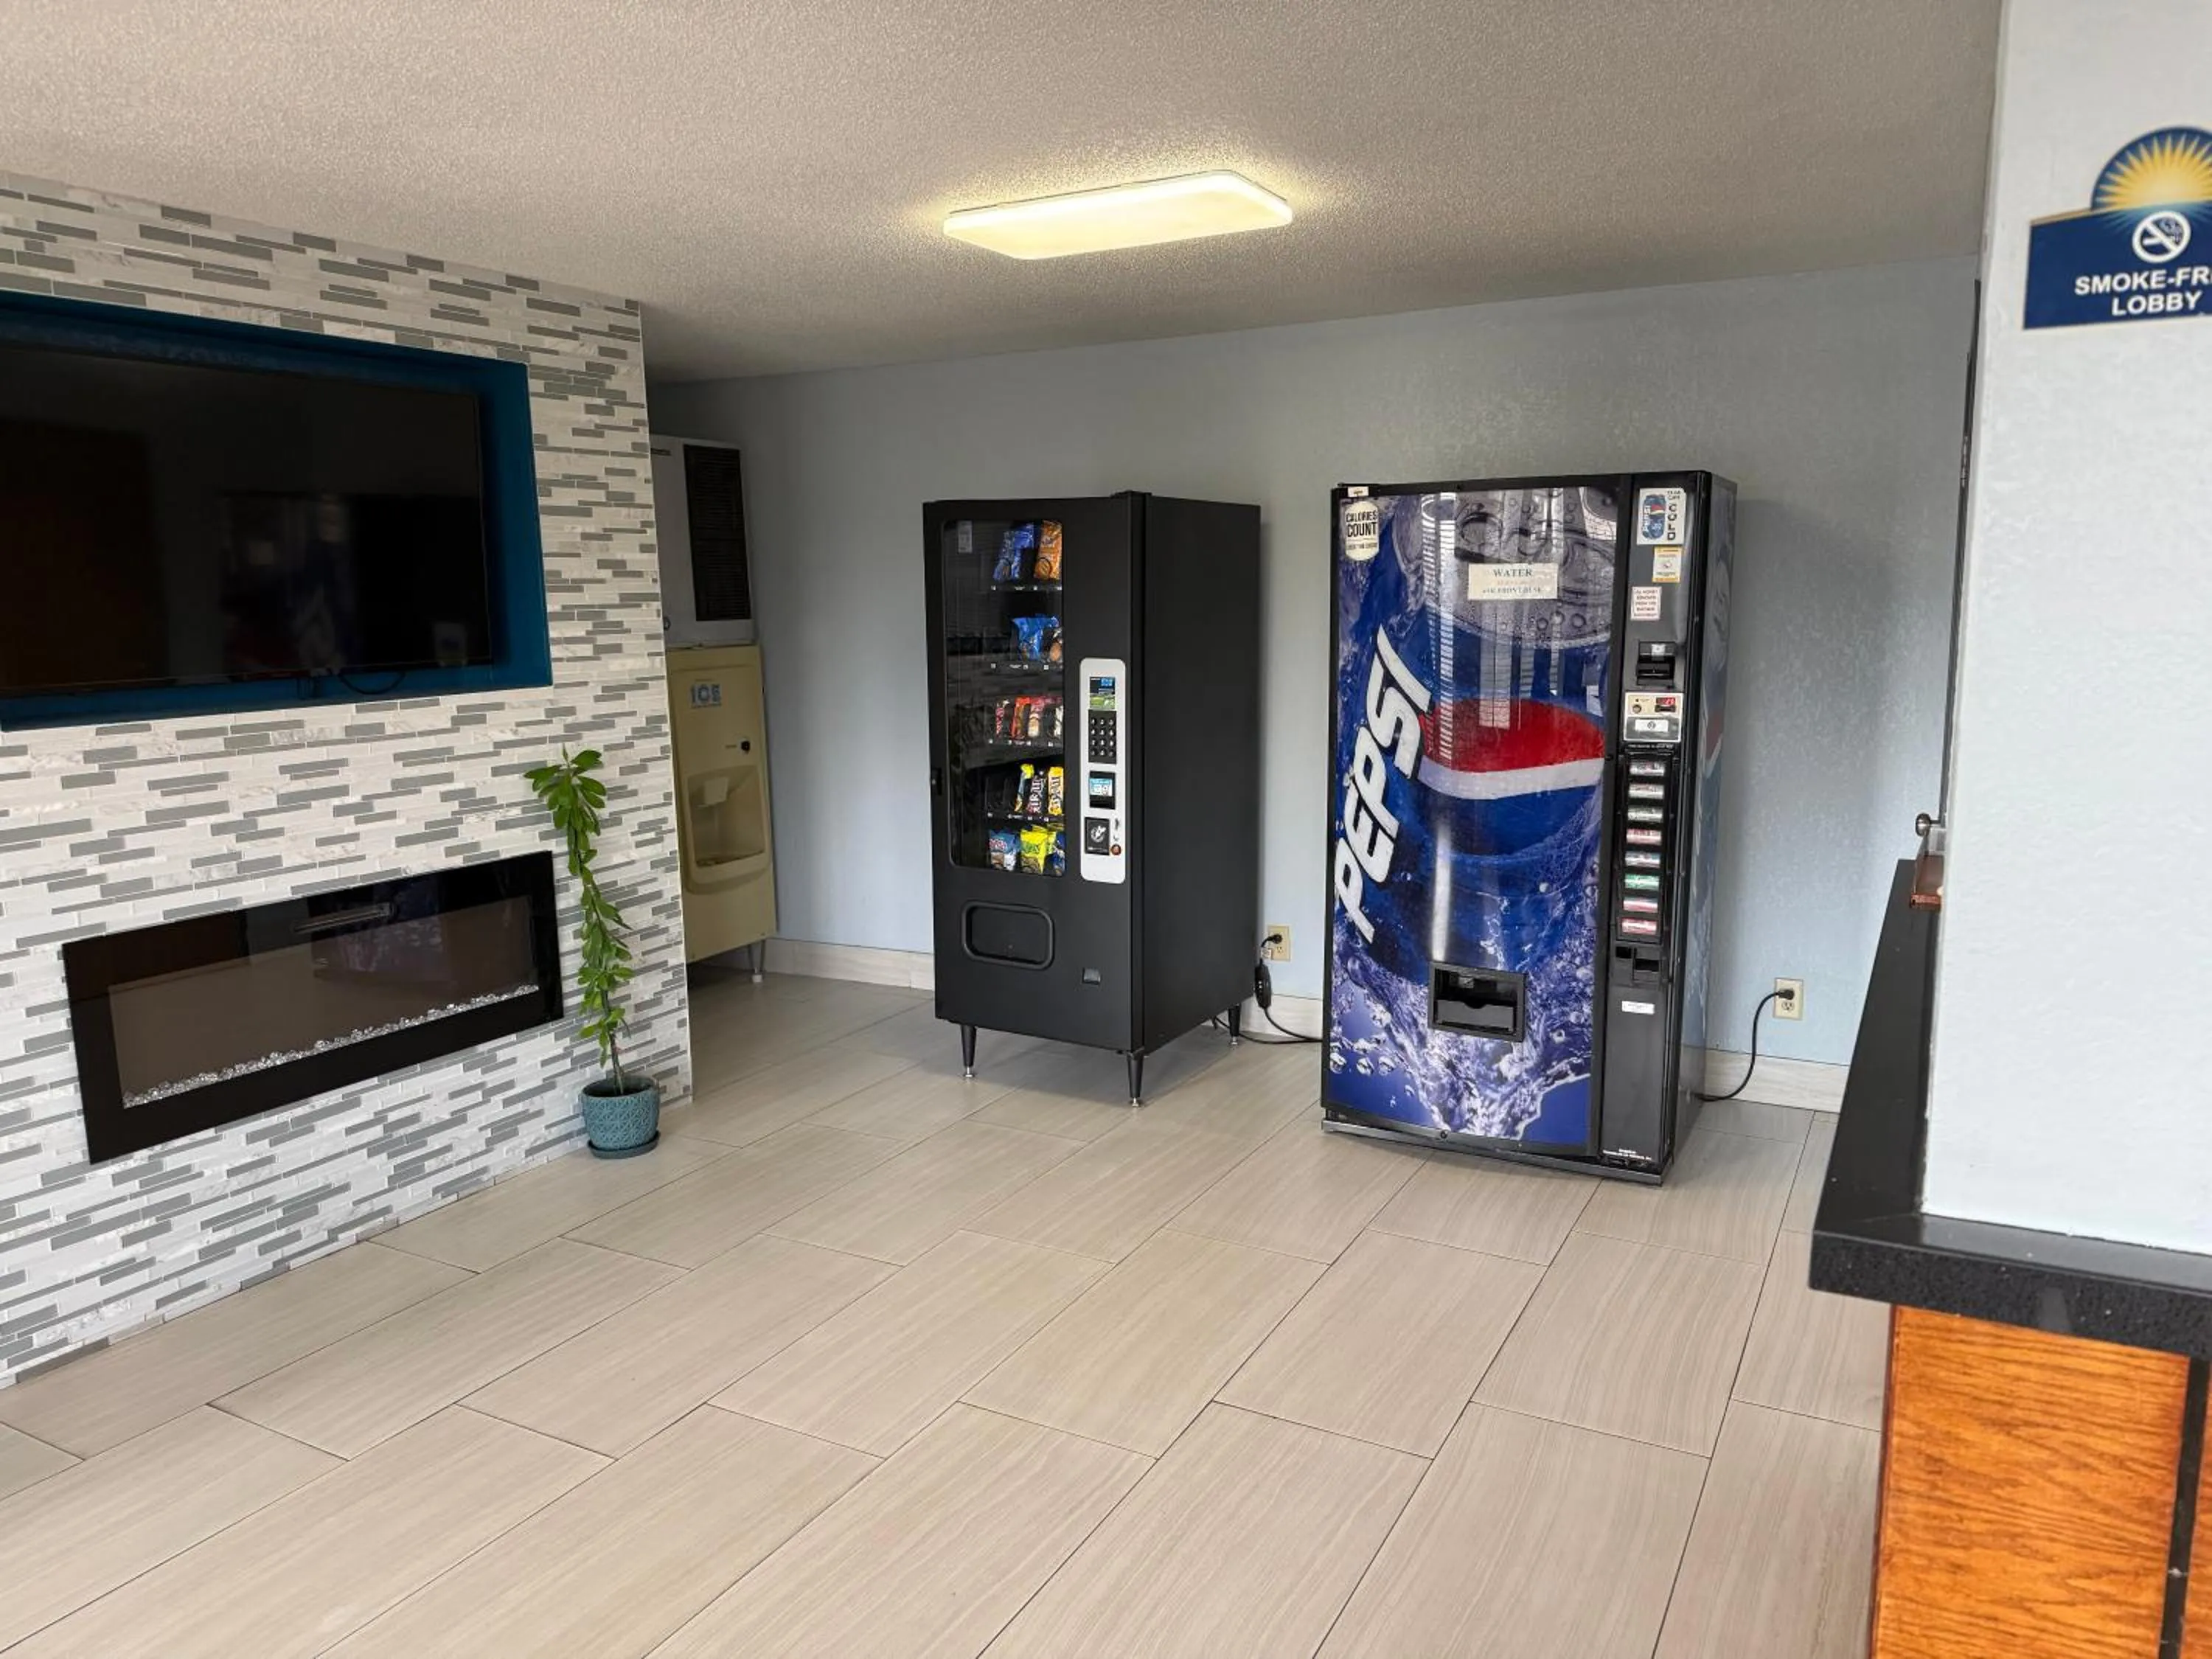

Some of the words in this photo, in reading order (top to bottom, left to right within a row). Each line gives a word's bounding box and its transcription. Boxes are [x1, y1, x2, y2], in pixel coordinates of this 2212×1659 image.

[2074, 266, 2212, 295] SMOKE-FR
[2111, 291, 2202, 316] LOBBY
[1346, 510, 1378, 523] CALORIES
[1667, 503, 1677, 540] COLD
[1347, 522, 1377, 538] COUNT
[1493, 568, 1533, 577] WATER
[1334, 623, 1432, 944] PEPSI
